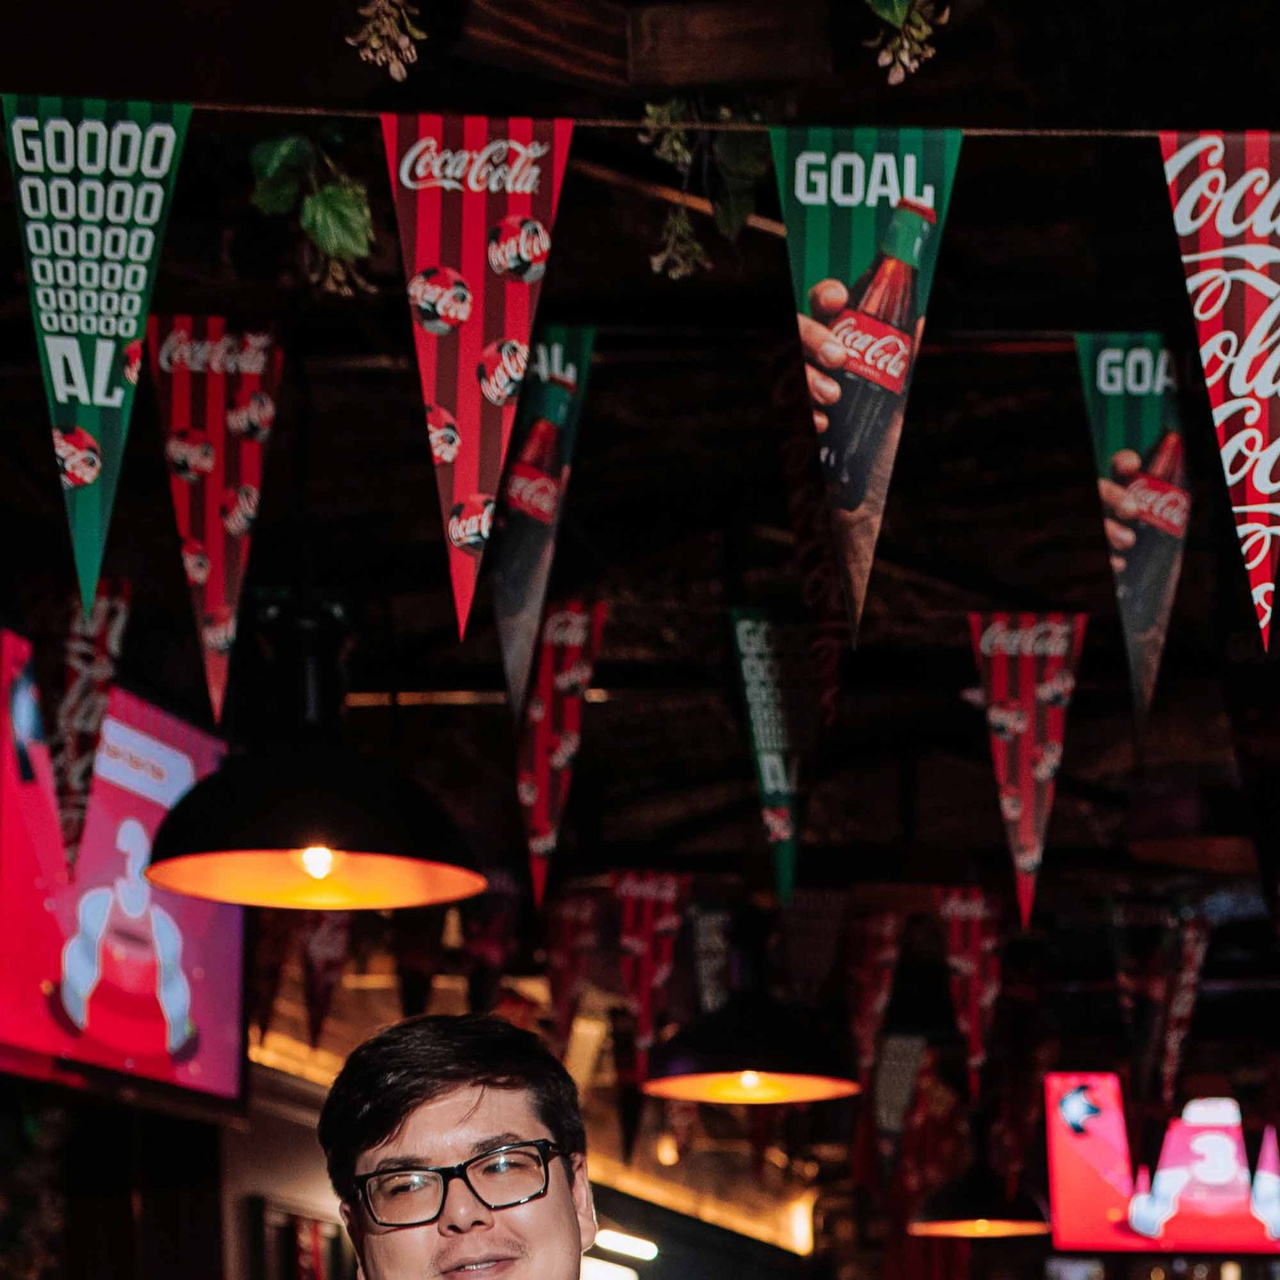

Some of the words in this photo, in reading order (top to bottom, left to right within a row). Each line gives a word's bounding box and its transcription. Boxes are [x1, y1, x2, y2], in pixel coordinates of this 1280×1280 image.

[12, 117, 177, 179] GOOOO
[795, 151, 935, 208] GOAL
[44, 335, 124, 408] AL
[1096, 348, 1177, 395] GOA
[1190, 1132, 1238, 1186] 3
